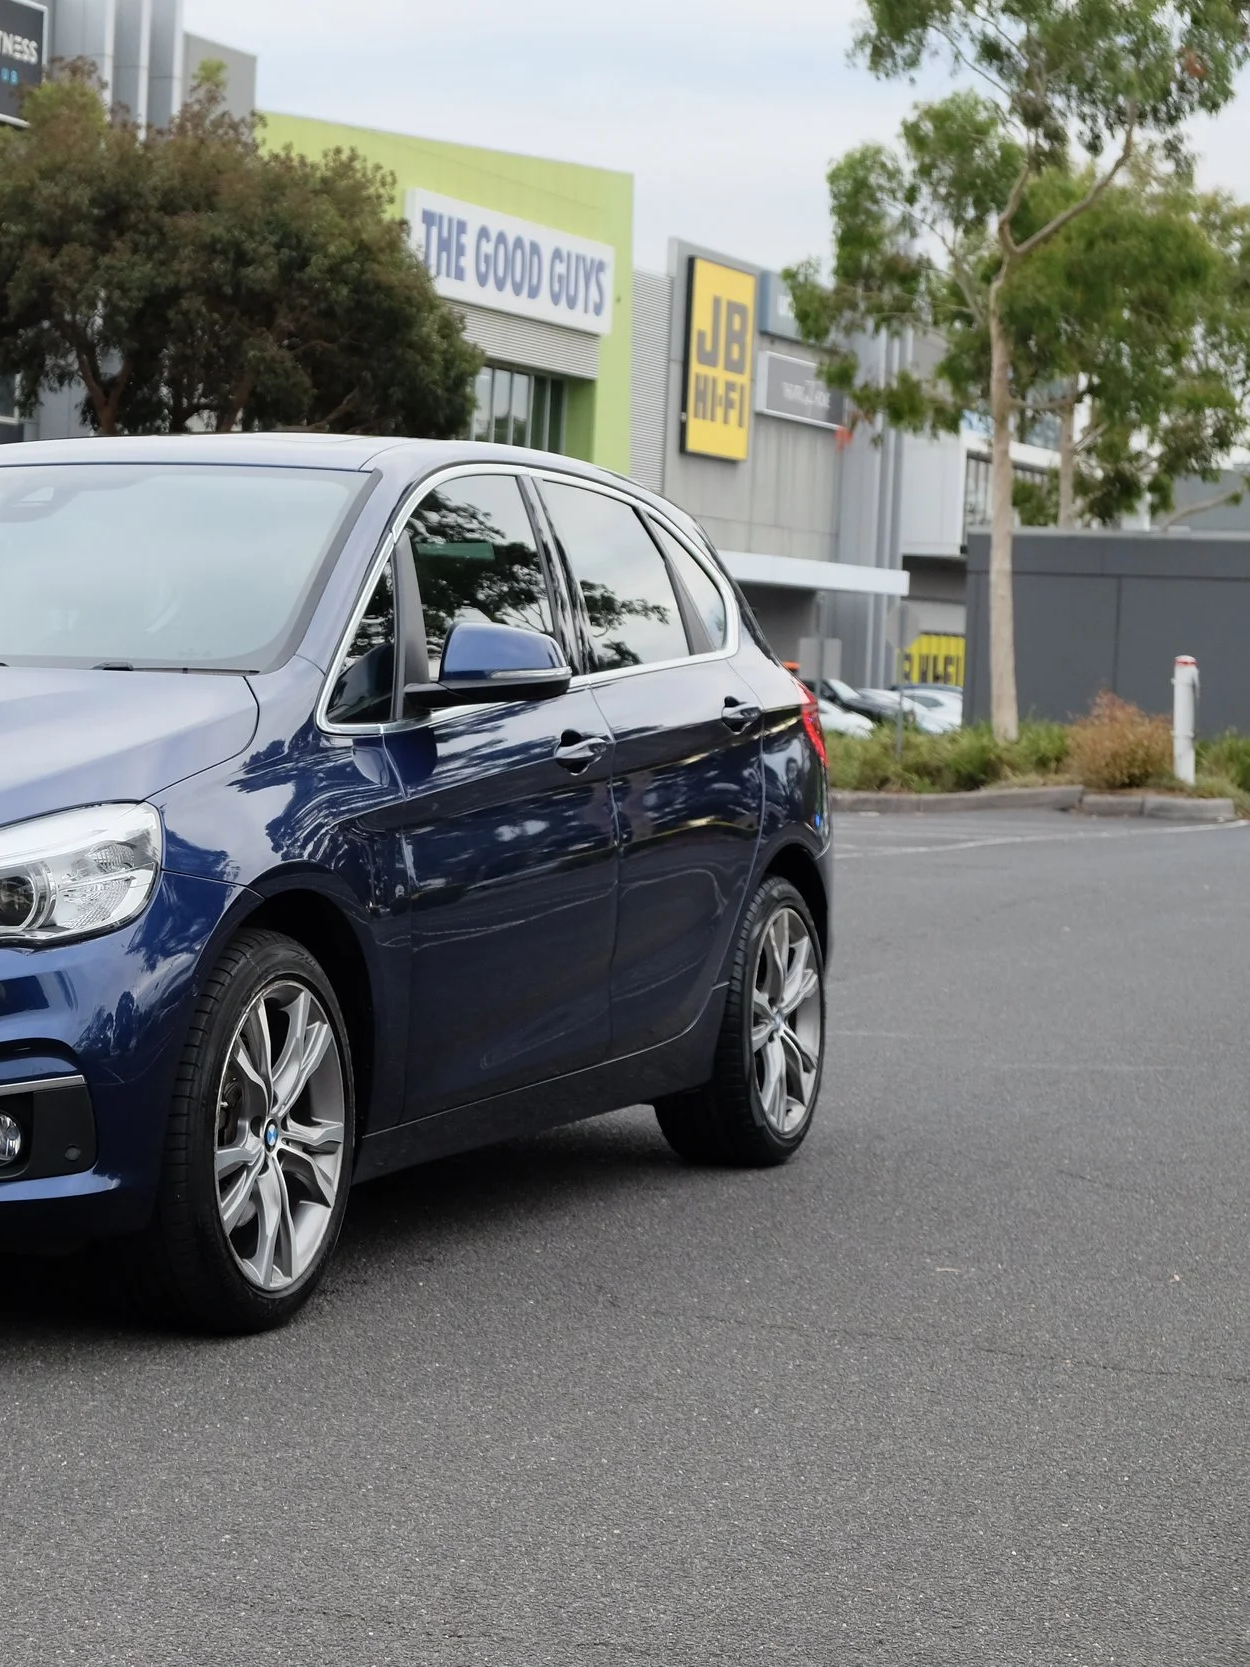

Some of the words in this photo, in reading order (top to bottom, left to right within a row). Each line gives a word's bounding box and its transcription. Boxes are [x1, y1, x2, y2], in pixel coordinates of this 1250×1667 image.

[422, 207, 467, 281] THE
[475, 225, 543, 300] GOOD
[549, 246, 606, 317] GUYS
[696, 295, 749, 376] JB
